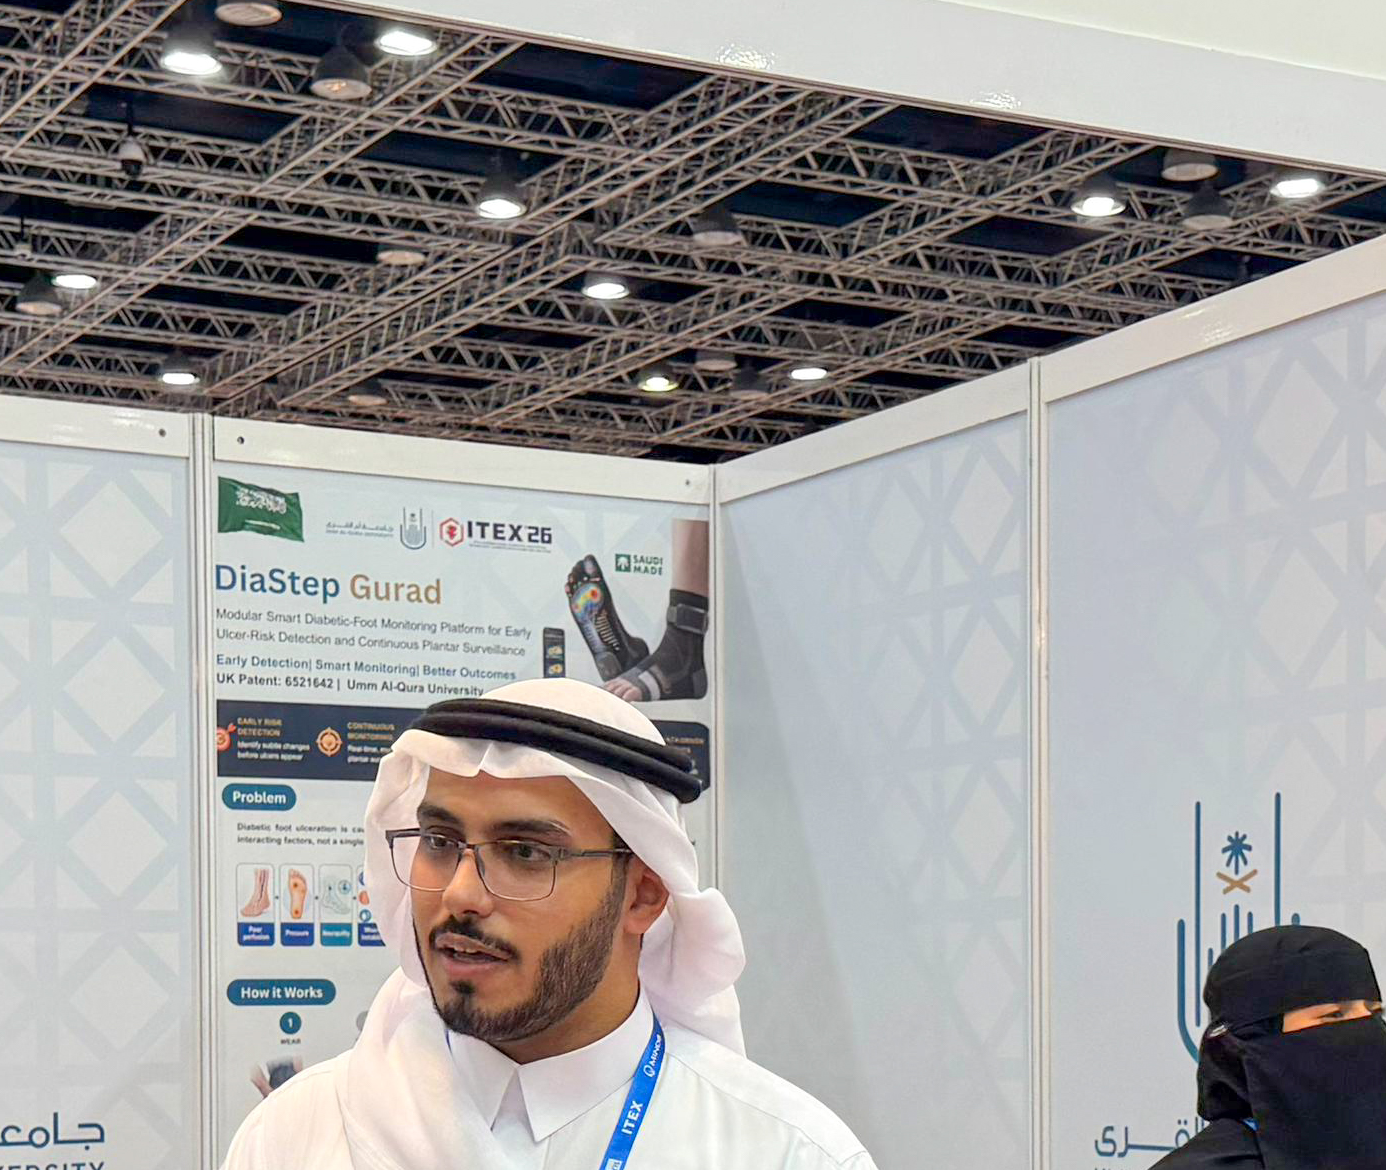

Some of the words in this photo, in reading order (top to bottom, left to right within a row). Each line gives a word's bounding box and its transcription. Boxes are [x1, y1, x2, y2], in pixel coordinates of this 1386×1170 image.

[633, 554, 663, 565] SAUDI
[633, 565, 663, 575] MADE
[215, 564, 341, 604] DiaStep
[350, 574, 442, 605] Gurad
[216, 608, 262, 621] Modular
[266, 611, 301, 623] Smart
[305, 613, 377, 628] Diabetic-Foot
[381, 618, 437, 634] Monitoring
[440, 622, 485, 635] Platform
[488, 624, 501, 636] for
[505, 626, 532, 640] Early
[216, 628, 275, 642] Ulcer-Risk
[278, 631, 331, 645] Detection
[334, 635, 355, 646] and
[358, 636, 420, 650] Continuous
[422, 640, 460, 652] Plantar
[463, 642, 526, 657] Surveillance
[216, 654, 247, 668] Early
[316, 659, 351, 671] Smart
[423, 665, 457, 677] Better
[460, 667, 516, 680] Outcomes
[216, 673, 235, 684] UK
[239, 674, 282, 687] Patent:
[347, 679, 377, 691] Umm
[381, 681, 424, 693] Al-Qura
[428, 682, 484, 697] University
[232, 790, 286, 804] Problem
[241, 987, 269, 999] How
[272, 987, 282, 999] it
[285, 986, 323, 999] Works
[621, 1100, 643, 1135] ITEX
